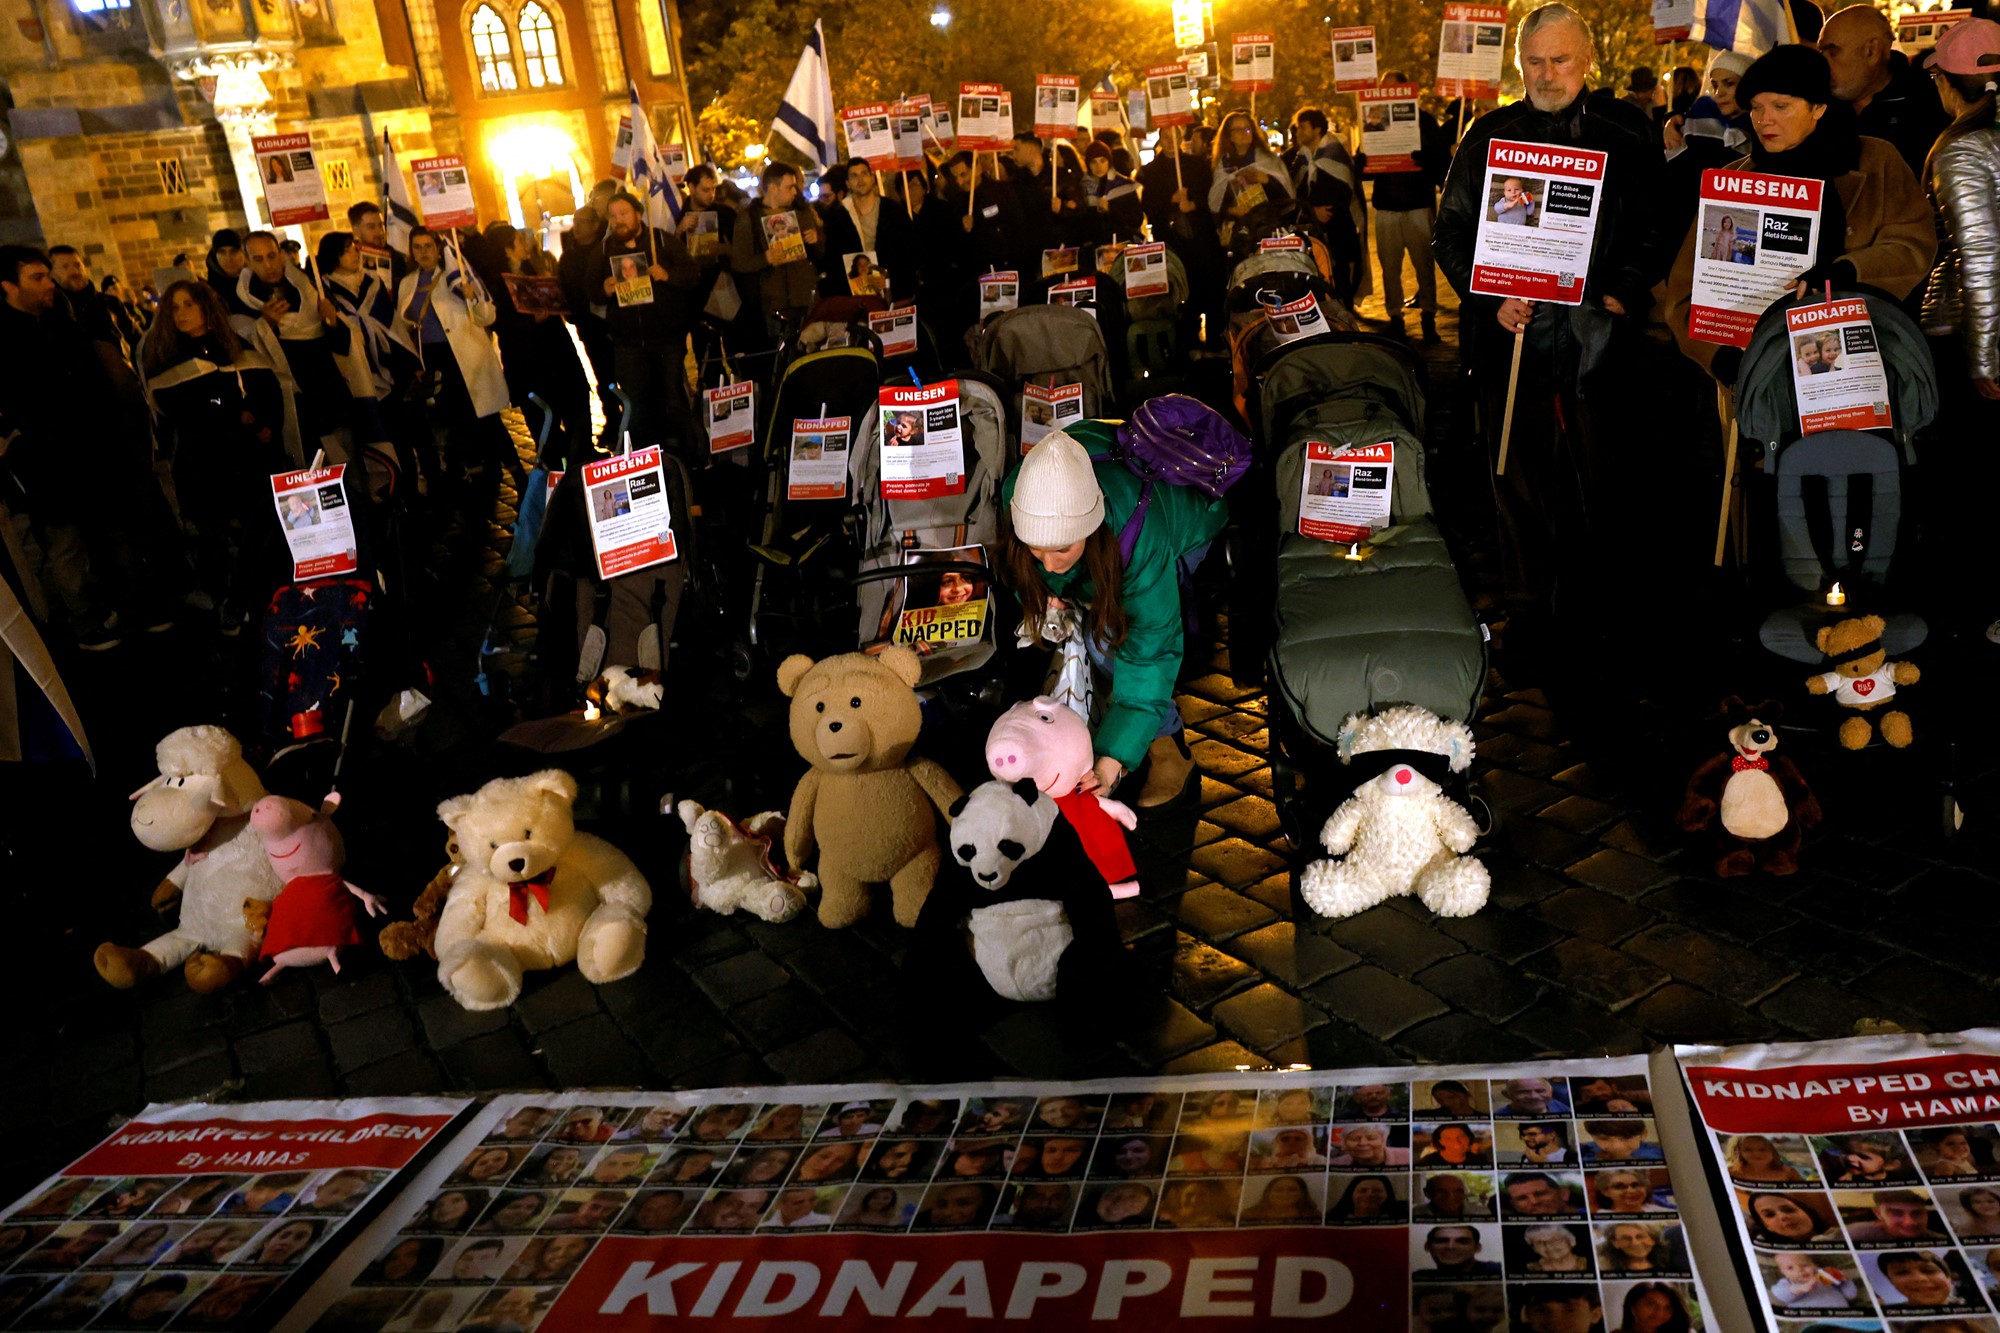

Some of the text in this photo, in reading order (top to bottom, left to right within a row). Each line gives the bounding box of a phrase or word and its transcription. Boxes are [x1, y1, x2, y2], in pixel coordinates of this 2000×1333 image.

[1450, 7, 1502, 18] UNESENA
[1237, 34, 1269, 42] UNESEN
[1334, 29, 1372, 38] KIDNAPPED
[1042, 76, 1075, 85] UNESEN
[1364, 87, 1412, 98] UNESEN
[847, 105, 884, 118] UNESEN
[257, 137, 308, 149] KIDNAPPED
[418, 158, 459, 169] UNESEN
[1495, 148, 1598, 172] KIDNAPPED
[1713, 176, 1809, 200] UNESENA
[1577, 193, 1591, 201] baby
[1764, 217, 1789, 231] Raz
[782, 243, 804, 259] PPED
[1501, 272, 1515, 280] help
[1515, 274, 1531, 283] bring
[616, 280, 632, 292] KID
[619, 286, 651, 304] NAPPED
[1267, 298, 1312, 314] UNESENA
[1791, 303, 1868, 325] KIDNAPPED
[715, 385, 747, 399] UNESEN
[894, 387, 946, 401] UNESEN
[796, 420, 848, 430] KIDNAPPED
[592, 453, 653, 479] UNESENA
[1354, 468, 1372, 477] Raz
[286, 469, 331, 485] UNESEN
[630, 478, 646, 488] Raz
[901, 608, 938, 628] KID
[899, 619, 982, 643] NAPPED
[1703, 1072, 1932, 1100] KIDNAPPED
[1846, 1094, 2000, 1125] By HAMA
[109, 1123, 433, 1146] KIDNAPPED CHILDREN
[176, 1150, 310, 1169] By HAMAS
[598, 1256, 1357, 1321] KIDNAPPED
